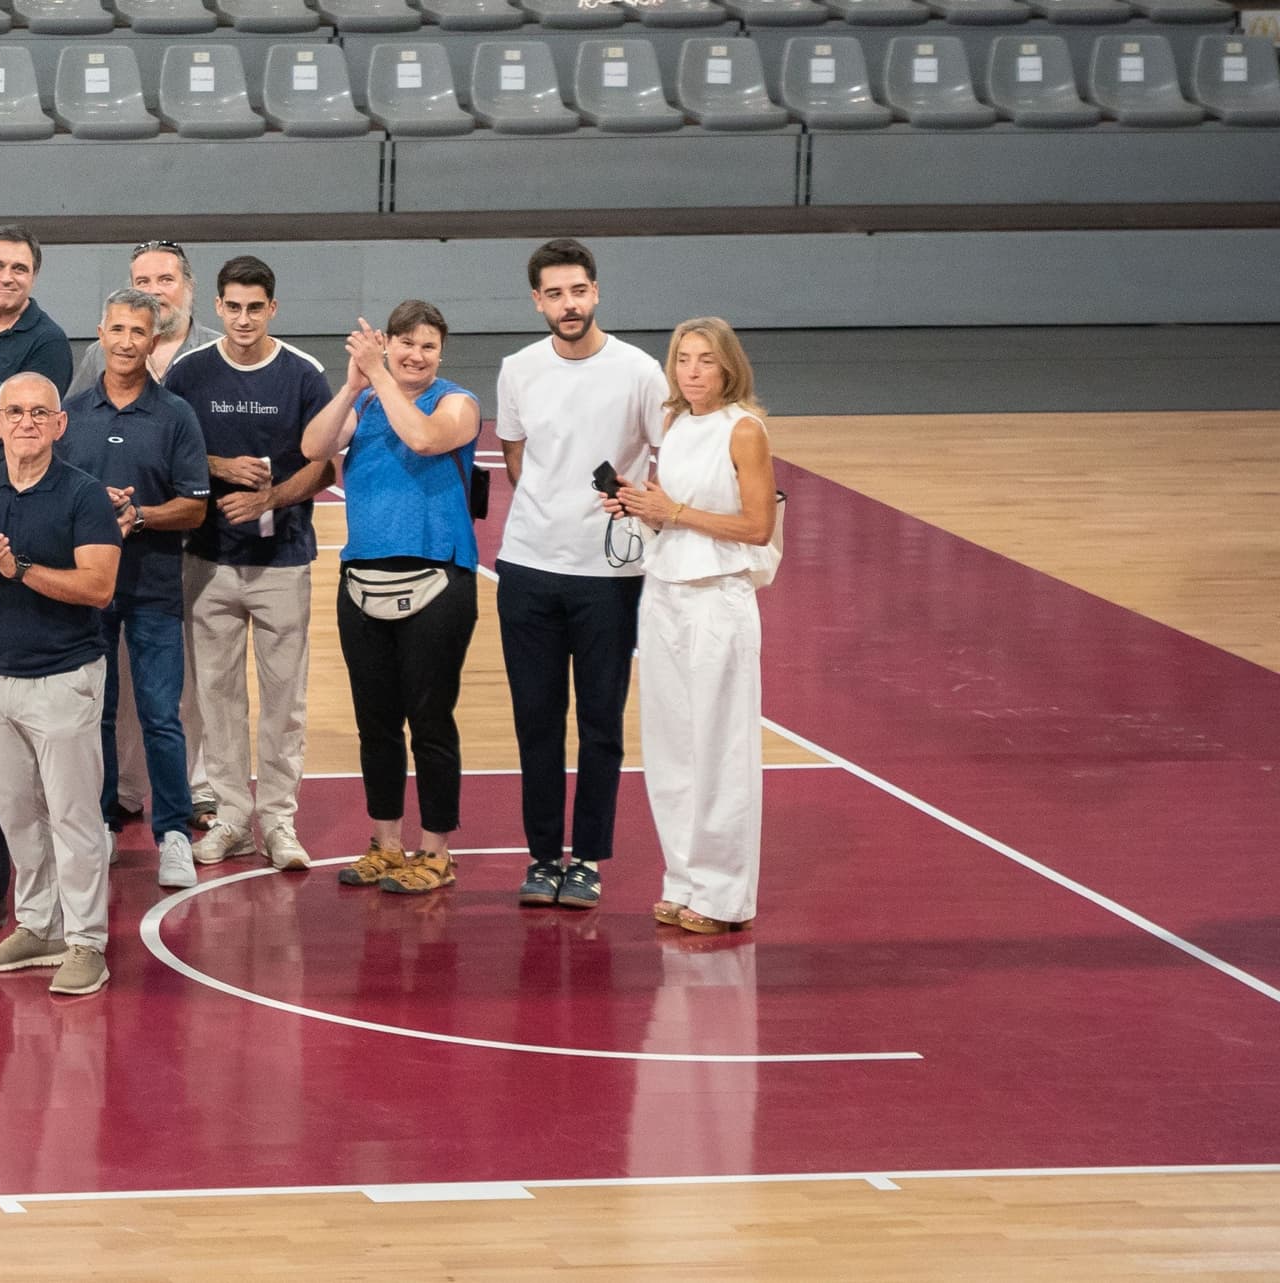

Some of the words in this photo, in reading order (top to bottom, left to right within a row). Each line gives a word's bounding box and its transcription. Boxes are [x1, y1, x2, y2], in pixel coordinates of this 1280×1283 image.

[211, 400, 234, 413] Pedro
[236, 400, 248, 413] del
[250, 401, 279, 414] Hierro
